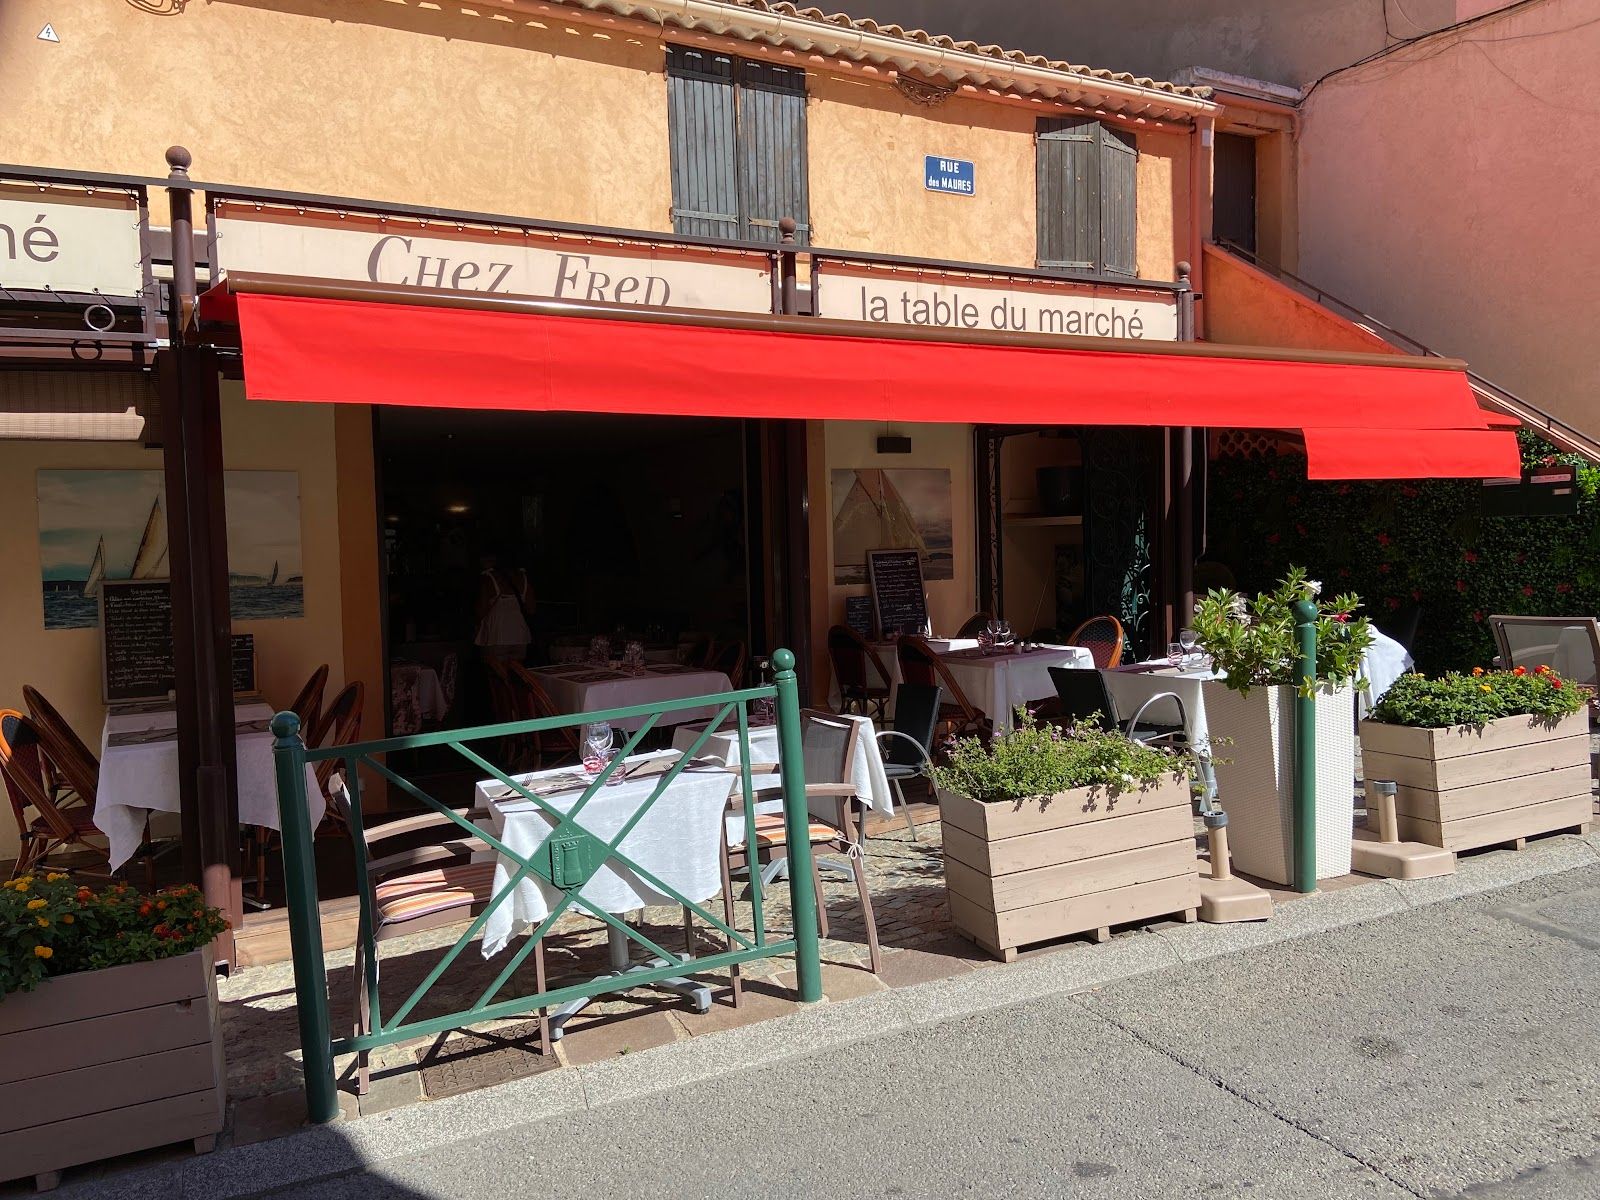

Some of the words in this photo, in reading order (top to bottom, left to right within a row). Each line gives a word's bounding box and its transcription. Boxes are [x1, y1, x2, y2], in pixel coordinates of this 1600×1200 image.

[940, 161, 960, 174] RUE
[928, 176, 940, 188] des
[942, 177, 971, 191] MAURES
[862, 286, 889, 322] la
[901, 291, 979, 328] table
[990, 298, 1027, 330] du
[1039, 306, 1143, 339] marché
